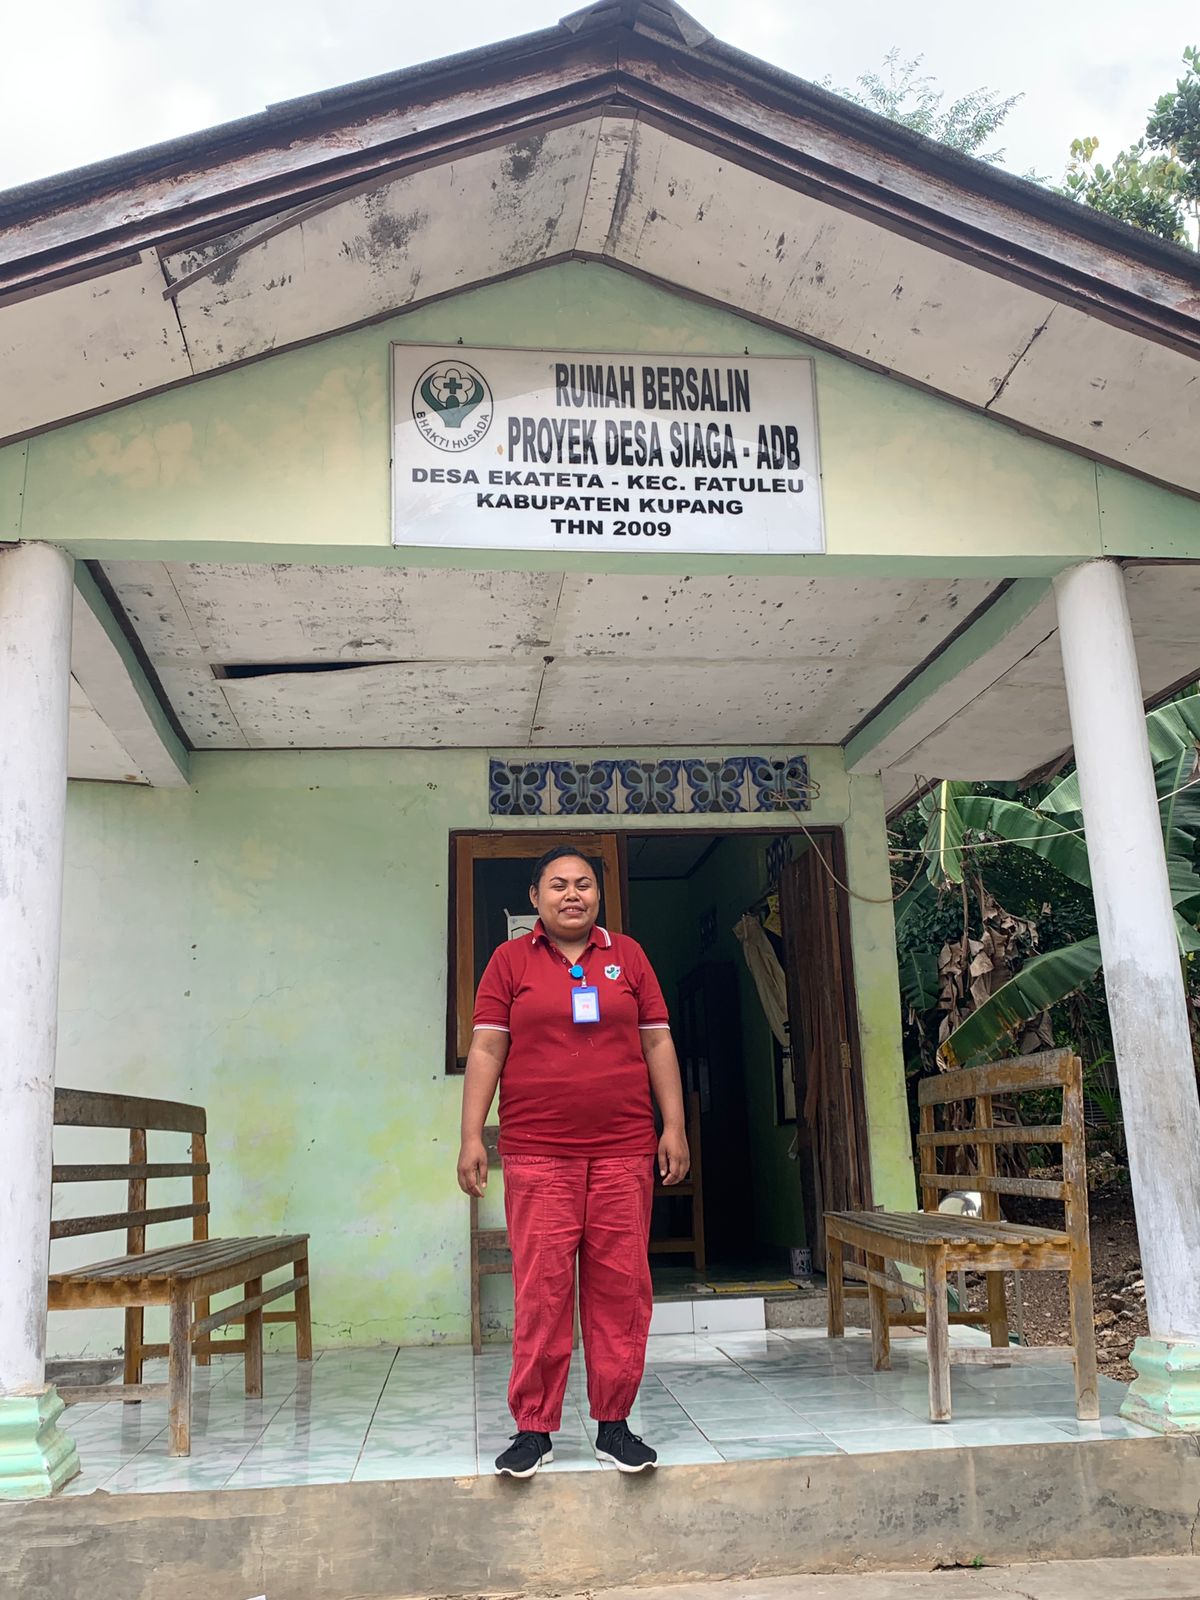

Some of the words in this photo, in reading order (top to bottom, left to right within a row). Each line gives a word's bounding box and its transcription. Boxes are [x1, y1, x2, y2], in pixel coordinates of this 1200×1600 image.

[555, 363, 635, 408] RUMAH
[643, 367, 750, 412] BERSALIN
[416, 411, 450, 448] BHAKTI
[452, 413, 490, 449] HUSADA
[508, 416, 598, 465] PROYEK
[605, 420, 662, 467] DESA
[670, 422, 738, 469] SIAGA
[757, 424, 801, 470] ADB
[412, 468, 479, 484] DESA
[489, 470, 604, 488] EKATETA
[628, 475, 686, 490] KEC.
[695, 477, 804, 493] FATULEU
[477, 493, 630, 512] KABUPATEN
[639, 498, 744, 515] KUPANG
[551, 518, 603, 535] THN
[613, 520, 672, 537] 2009
